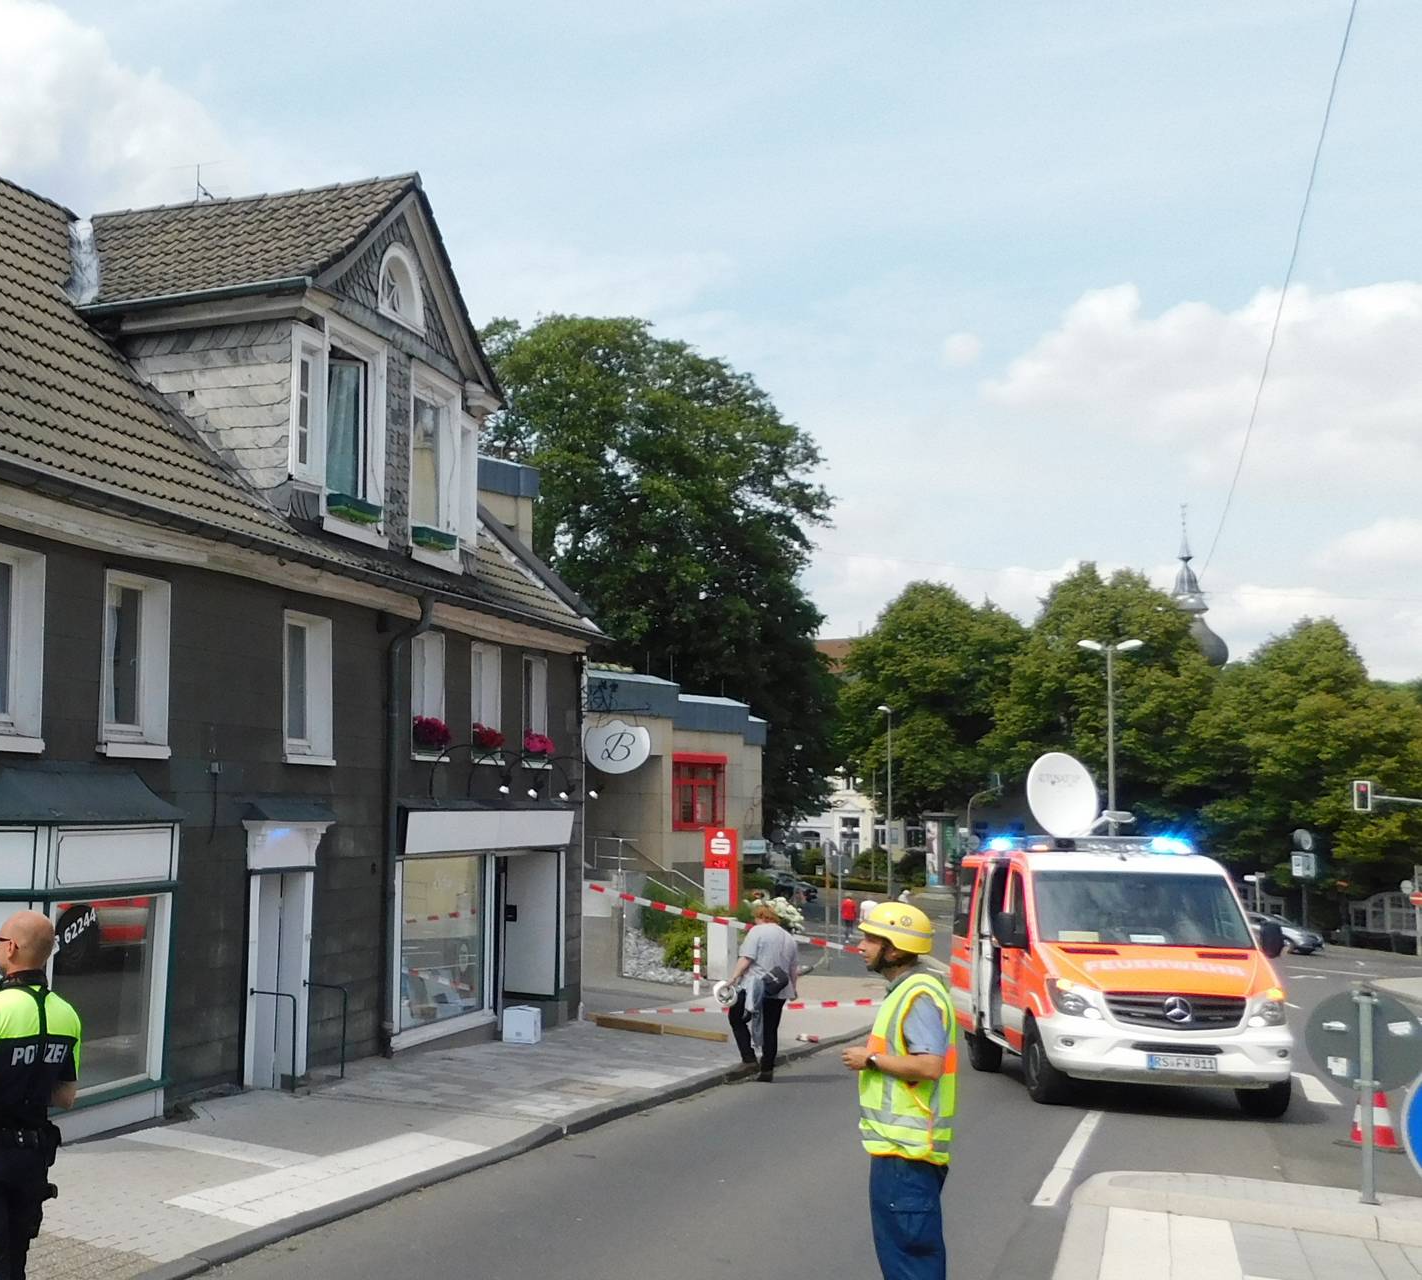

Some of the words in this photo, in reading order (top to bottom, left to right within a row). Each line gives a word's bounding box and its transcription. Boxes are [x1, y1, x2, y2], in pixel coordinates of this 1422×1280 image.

[601, 731, 636, 762] B
[64, 907, 97, 944] 62244
[11, 1043, 68, 1067] POZEI
[1155, 1056, 1170, 1067] RS
[1194, 1059, 1215, 1069] 811
